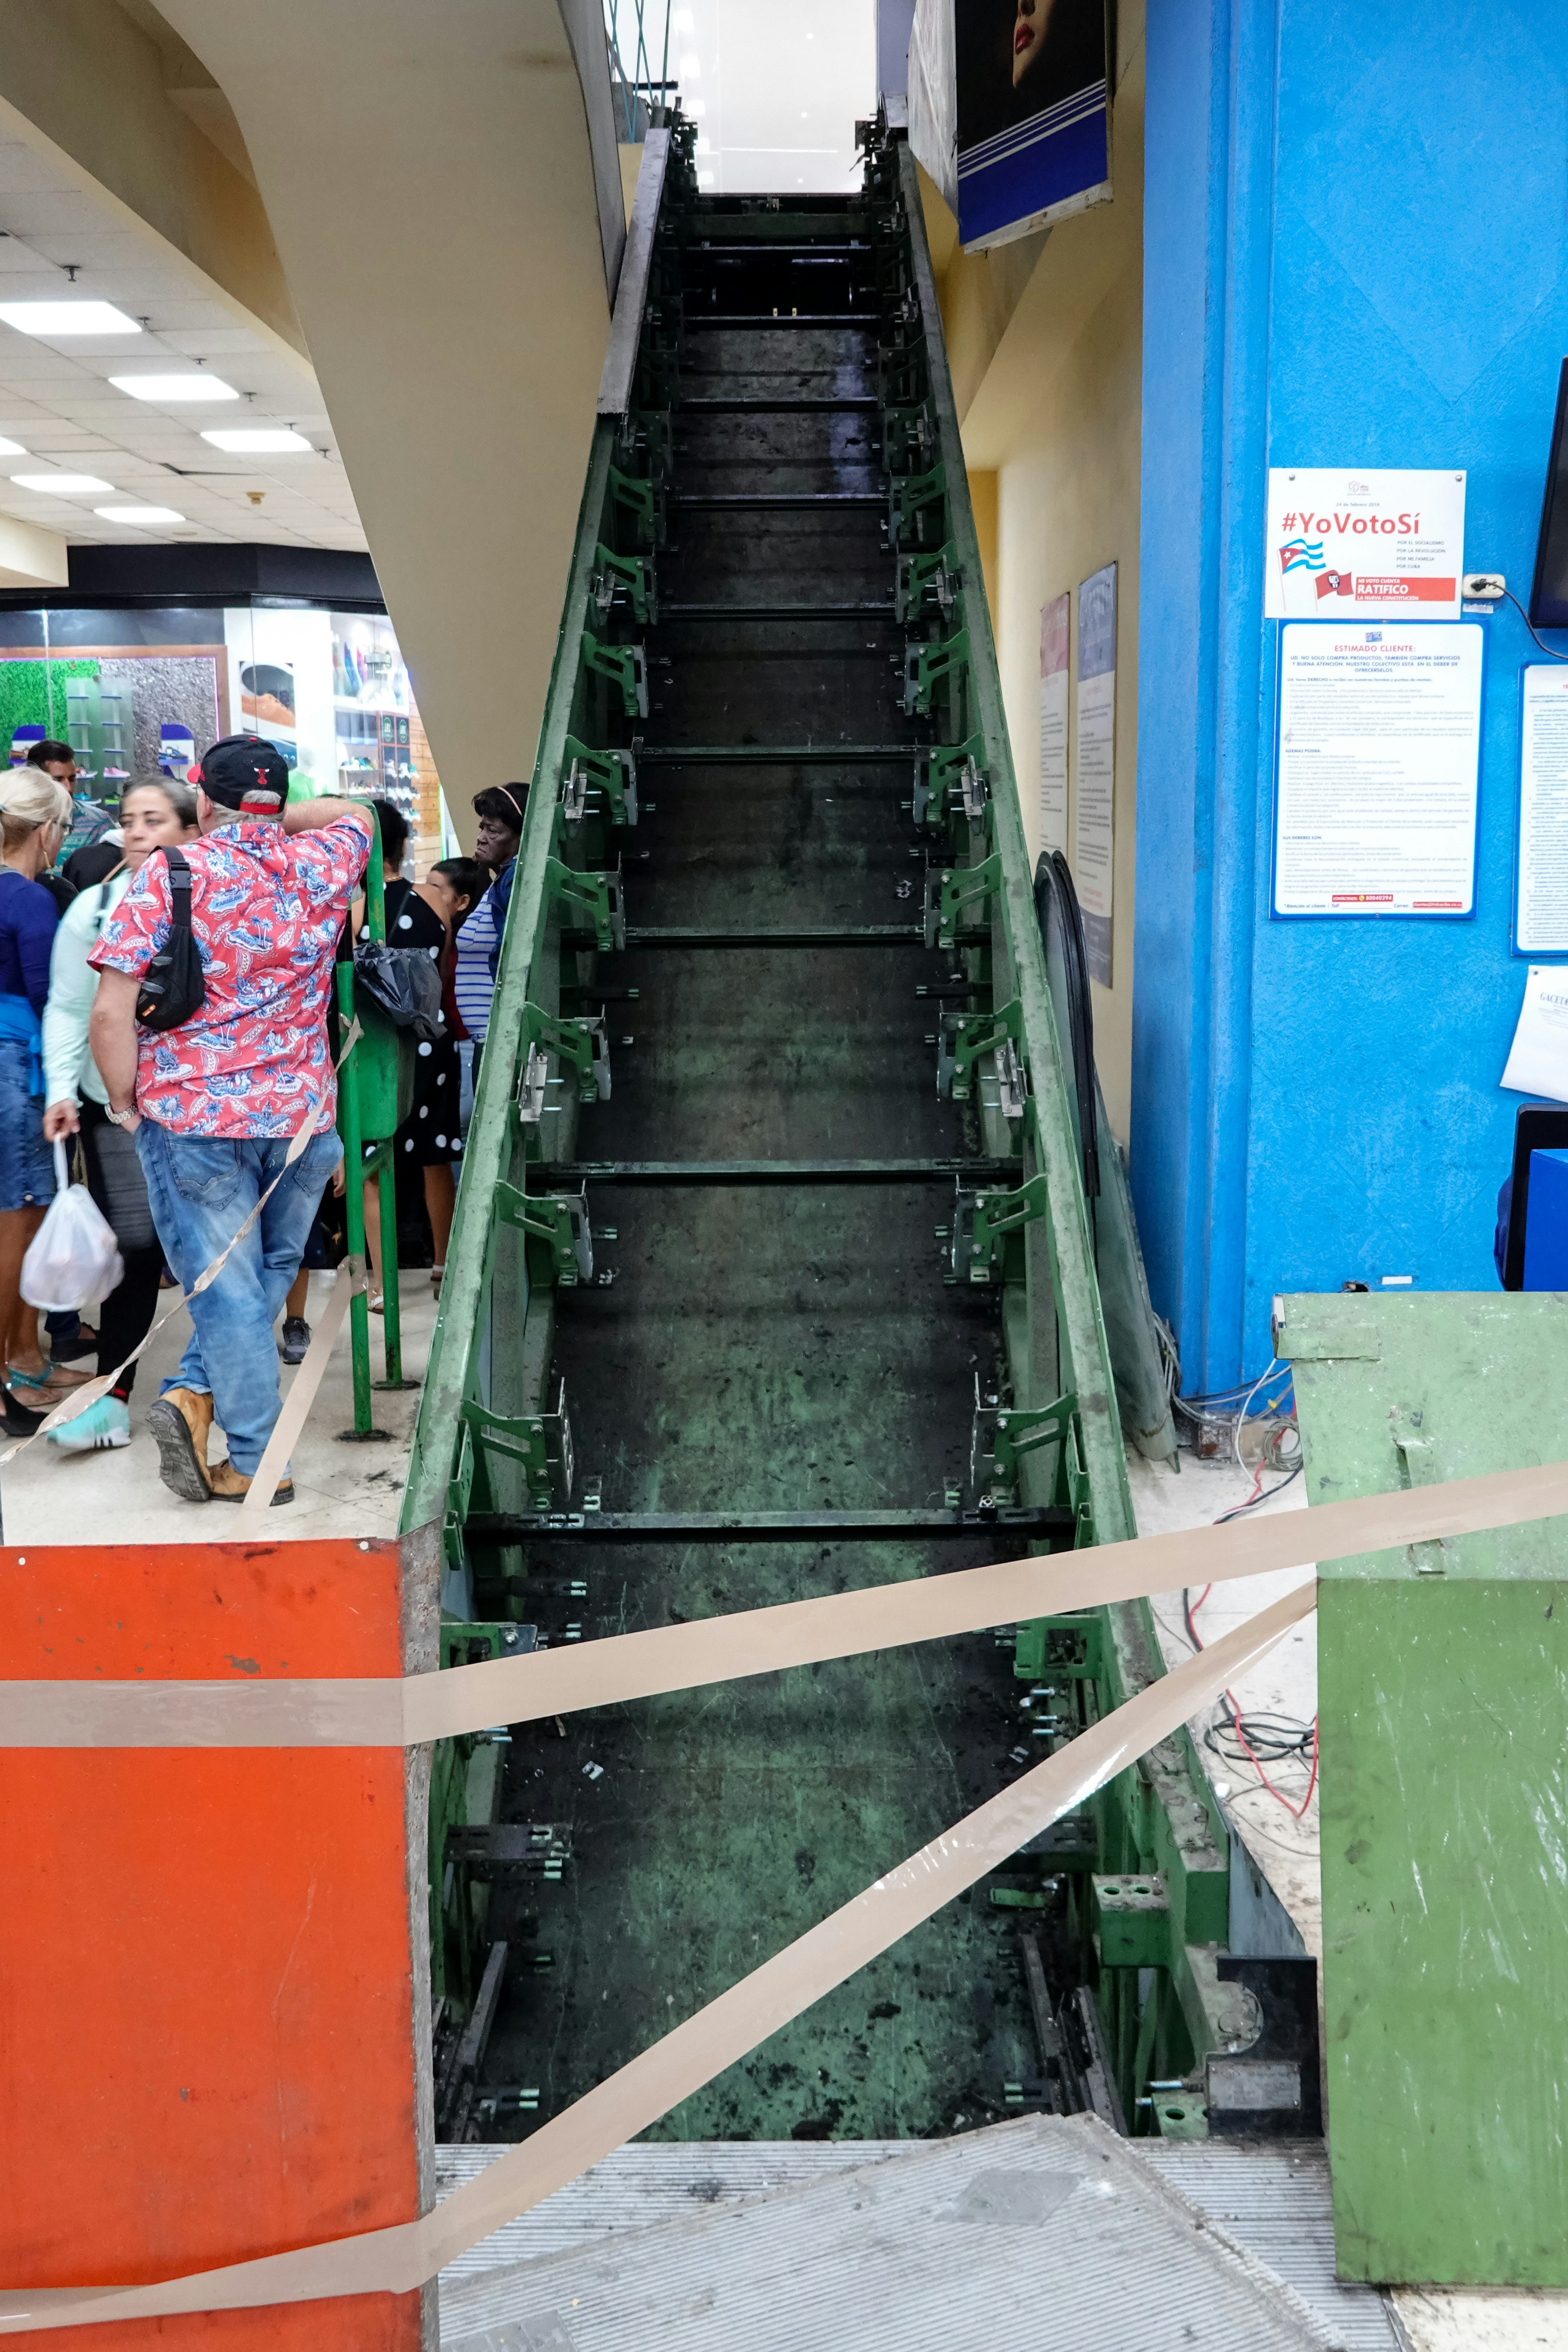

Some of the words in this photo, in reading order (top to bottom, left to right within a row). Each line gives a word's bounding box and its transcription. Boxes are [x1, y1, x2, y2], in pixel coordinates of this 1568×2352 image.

[1281, 513, 1421, 533] #YoVotoSí
[1357, 584, 1408, 594] RATIFICO
[269, 1003, 283, 1012] OAHU
[269, 1125, 283, 1136] OAHU
